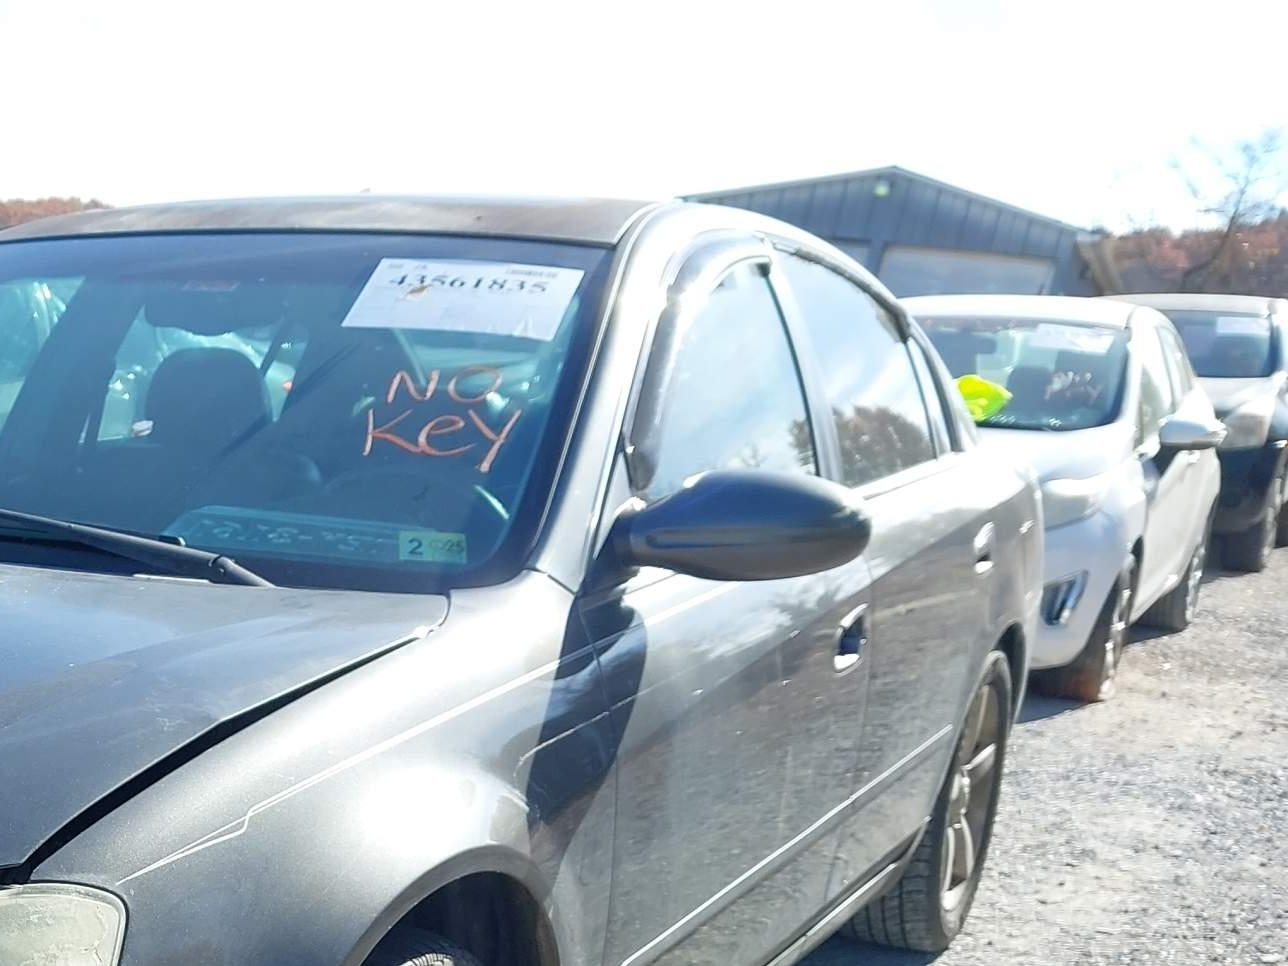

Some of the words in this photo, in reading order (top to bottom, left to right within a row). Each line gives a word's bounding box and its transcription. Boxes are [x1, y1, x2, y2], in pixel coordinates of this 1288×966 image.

[388, 272, 550, 295] 43561835
[386, 364, 504, 404] NO
[407, 536, 424, 556] 2
